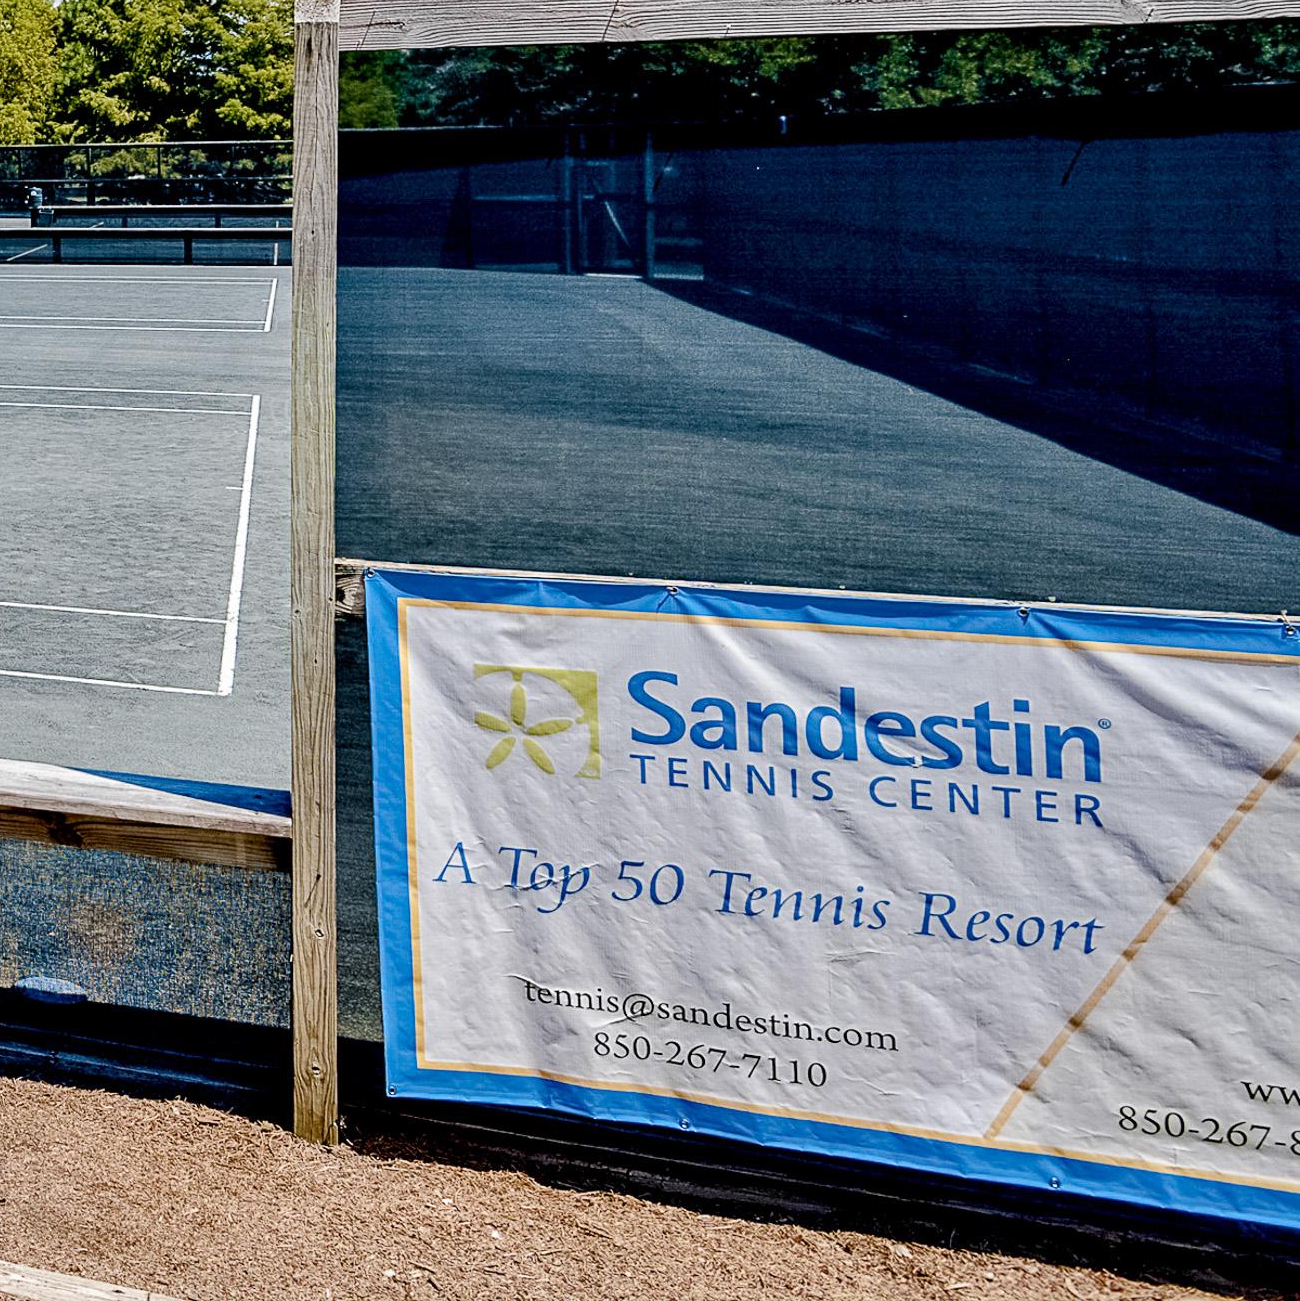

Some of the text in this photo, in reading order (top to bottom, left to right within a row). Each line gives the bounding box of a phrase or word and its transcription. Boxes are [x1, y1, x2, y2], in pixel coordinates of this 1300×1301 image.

[630, 754, 1103, 827] TENNIS CENTER
[433, 842, 1106, 954] A Top 50 Tennis Resort
[524, 980, 899, 1052] tennis@sandestin.com
[593, 1032, 827, 1087] 850-267-7110
